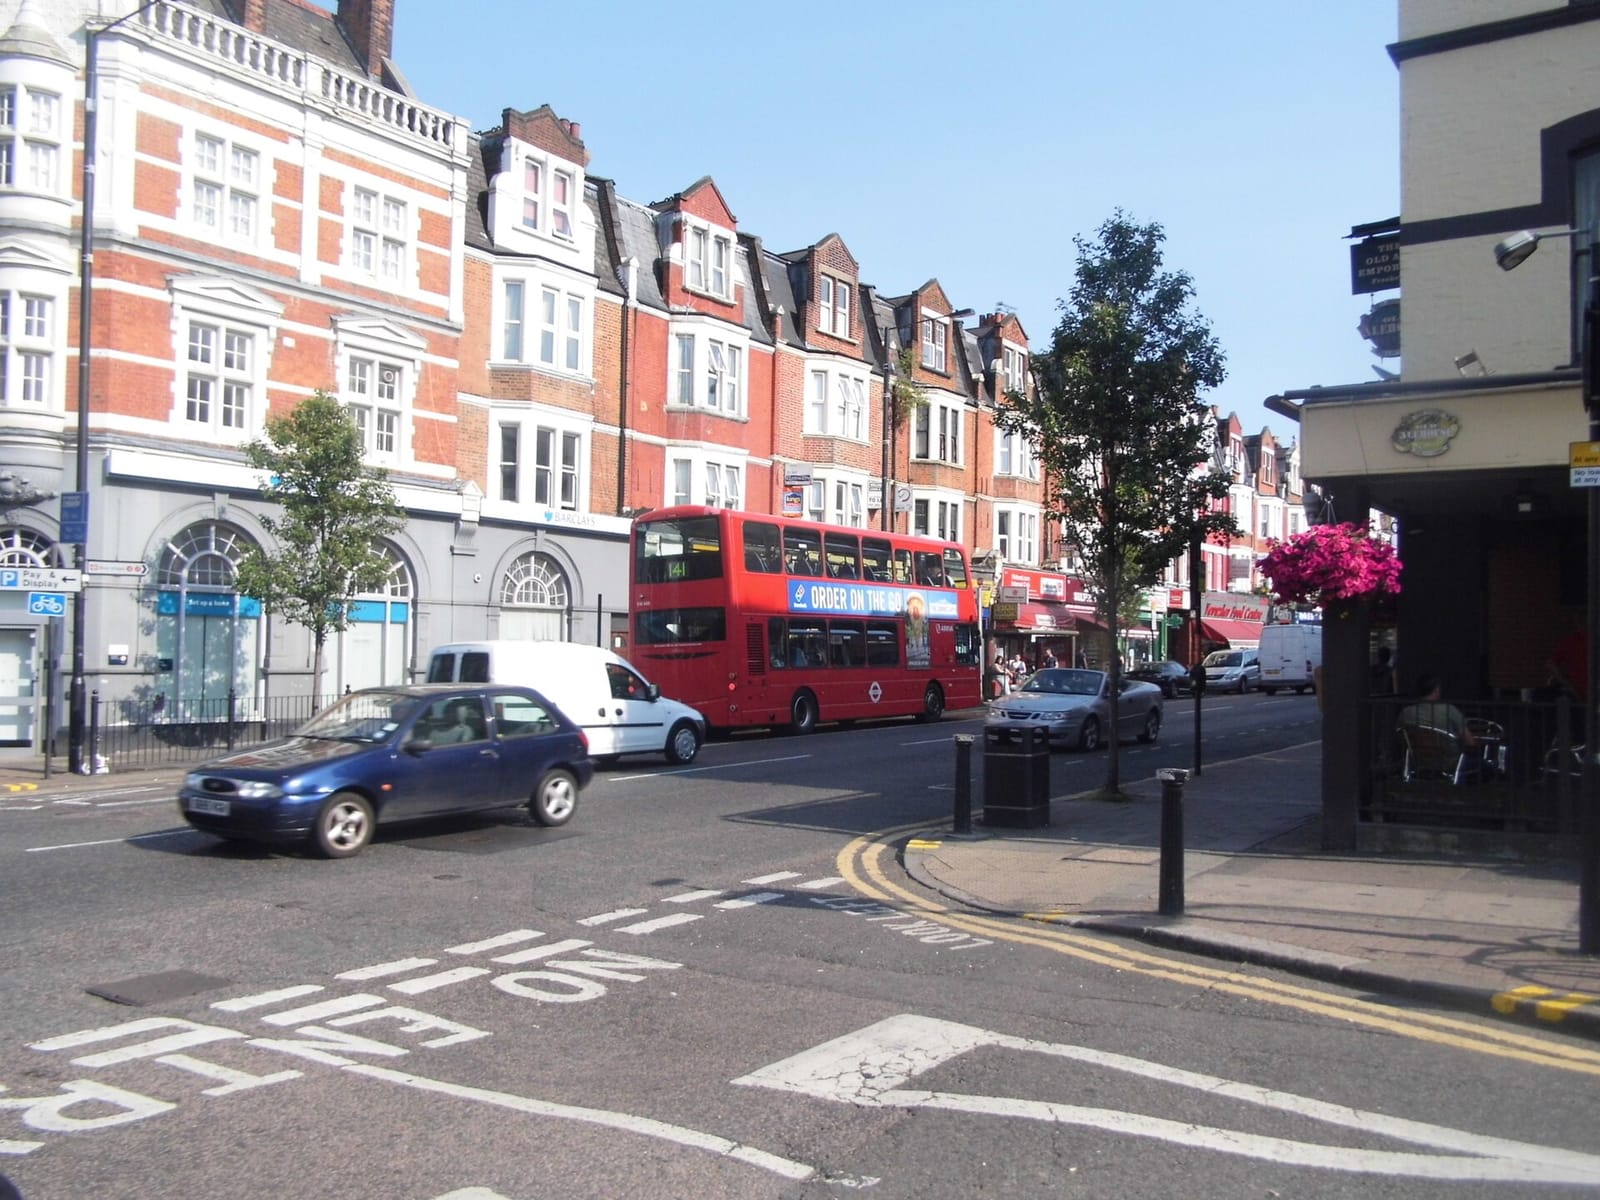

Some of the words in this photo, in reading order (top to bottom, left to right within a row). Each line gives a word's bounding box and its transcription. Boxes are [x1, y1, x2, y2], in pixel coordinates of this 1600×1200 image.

[1366, 254, 1389, 265] OLD
[555, 512, 596, 526] BARCLAYS
[23, 570, 41, 579] Pay
[669, 561, 685, 577] 141
[23, 579, 59, 588] Display
[811, 585, 847, 609] ORDER
[851, 589, 865, 610] ON
[867, 590, 886, 612] THE
[888, 591, 901, 612] GO
[881, 920, 994, 950] LOOK
[490, 949, 684, 1002] NO
